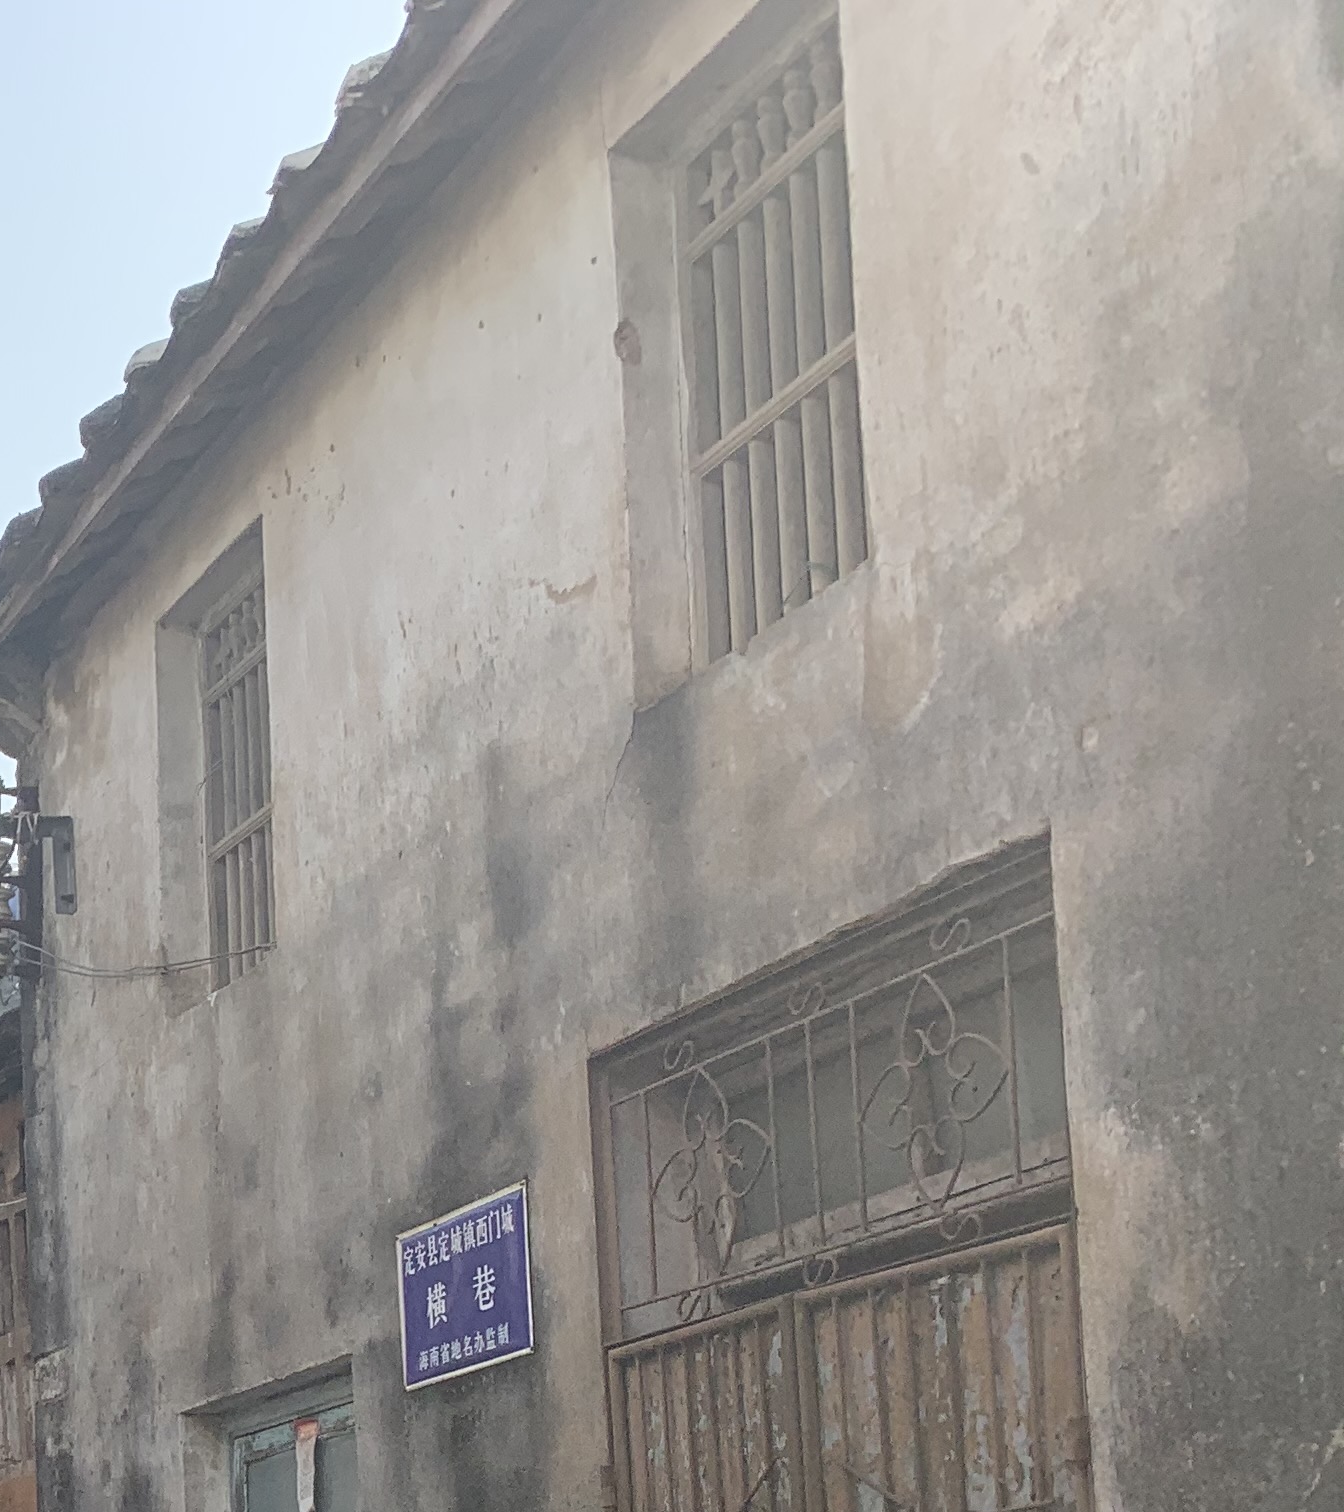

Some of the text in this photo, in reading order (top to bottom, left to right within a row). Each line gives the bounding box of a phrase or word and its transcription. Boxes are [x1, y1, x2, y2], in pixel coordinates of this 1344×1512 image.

[425, 1263, 497, 1330] 横巷
[418, 1321, 510, 1371] 海南省地名办监制
